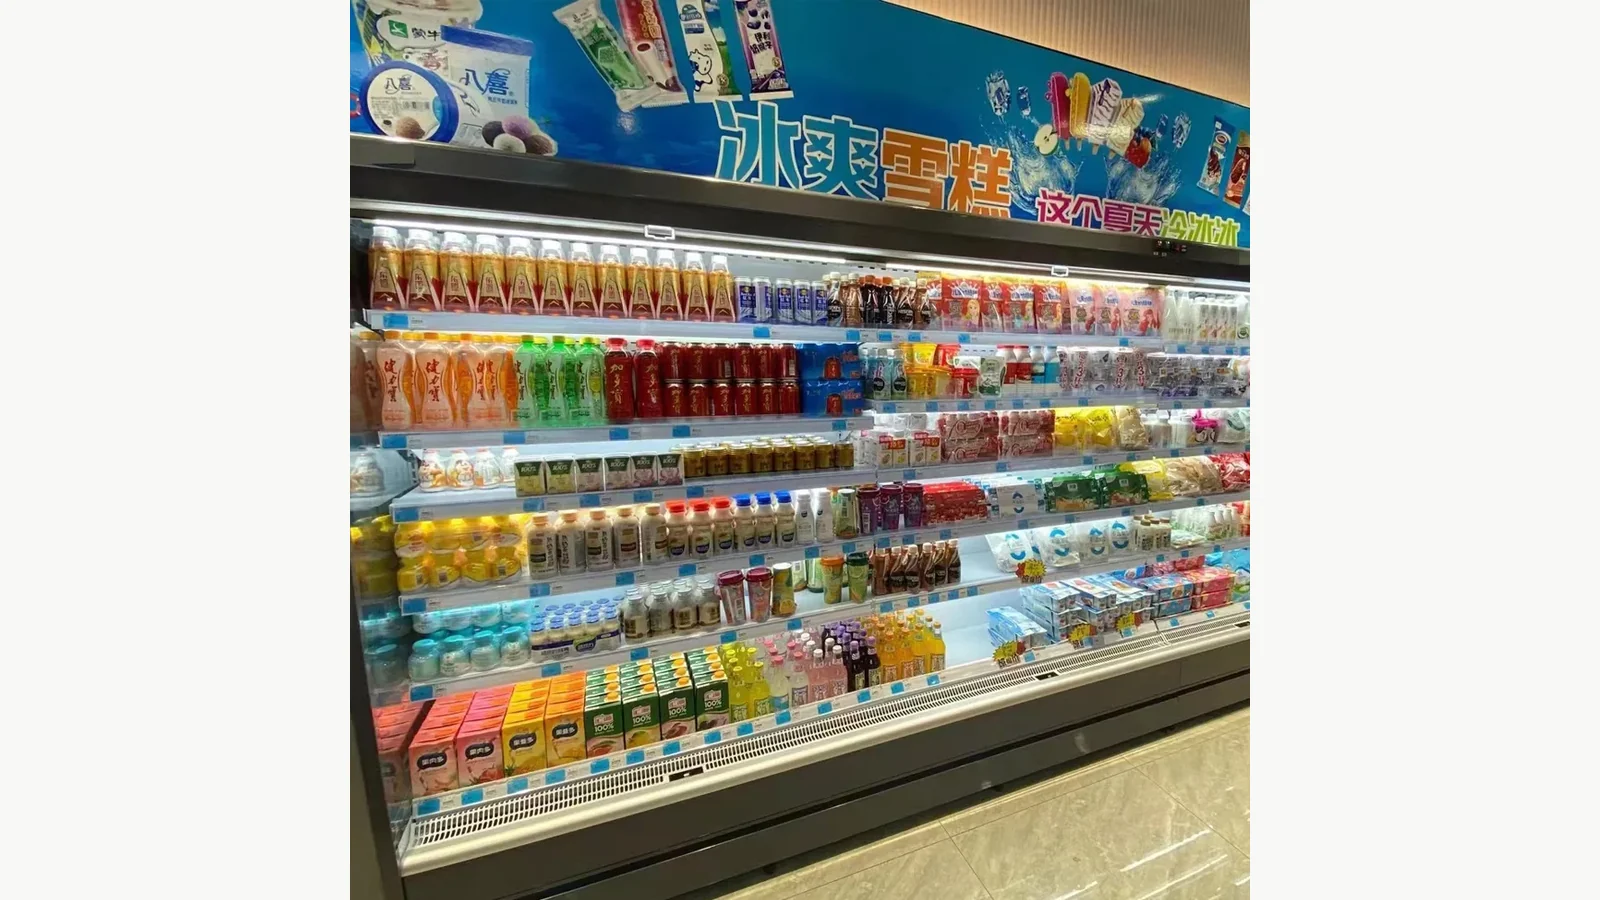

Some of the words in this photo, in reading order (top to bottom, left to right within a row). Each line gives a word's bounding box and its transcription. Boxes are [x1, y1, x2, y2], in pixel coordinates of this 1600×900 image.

[411, 27, 441, 41] 蒙牛
[384, 74, 413, 95] 八喜
[459, 68, 511, 95] 八喜
[714, 100, 1012, 219] 冰爽雪糕
[704, 699, 722, 708] 100%
[669, 706, 687, 716] 100%
[632, 714, 652, 724] 100%
[594, 723, 615, 733] 100%
